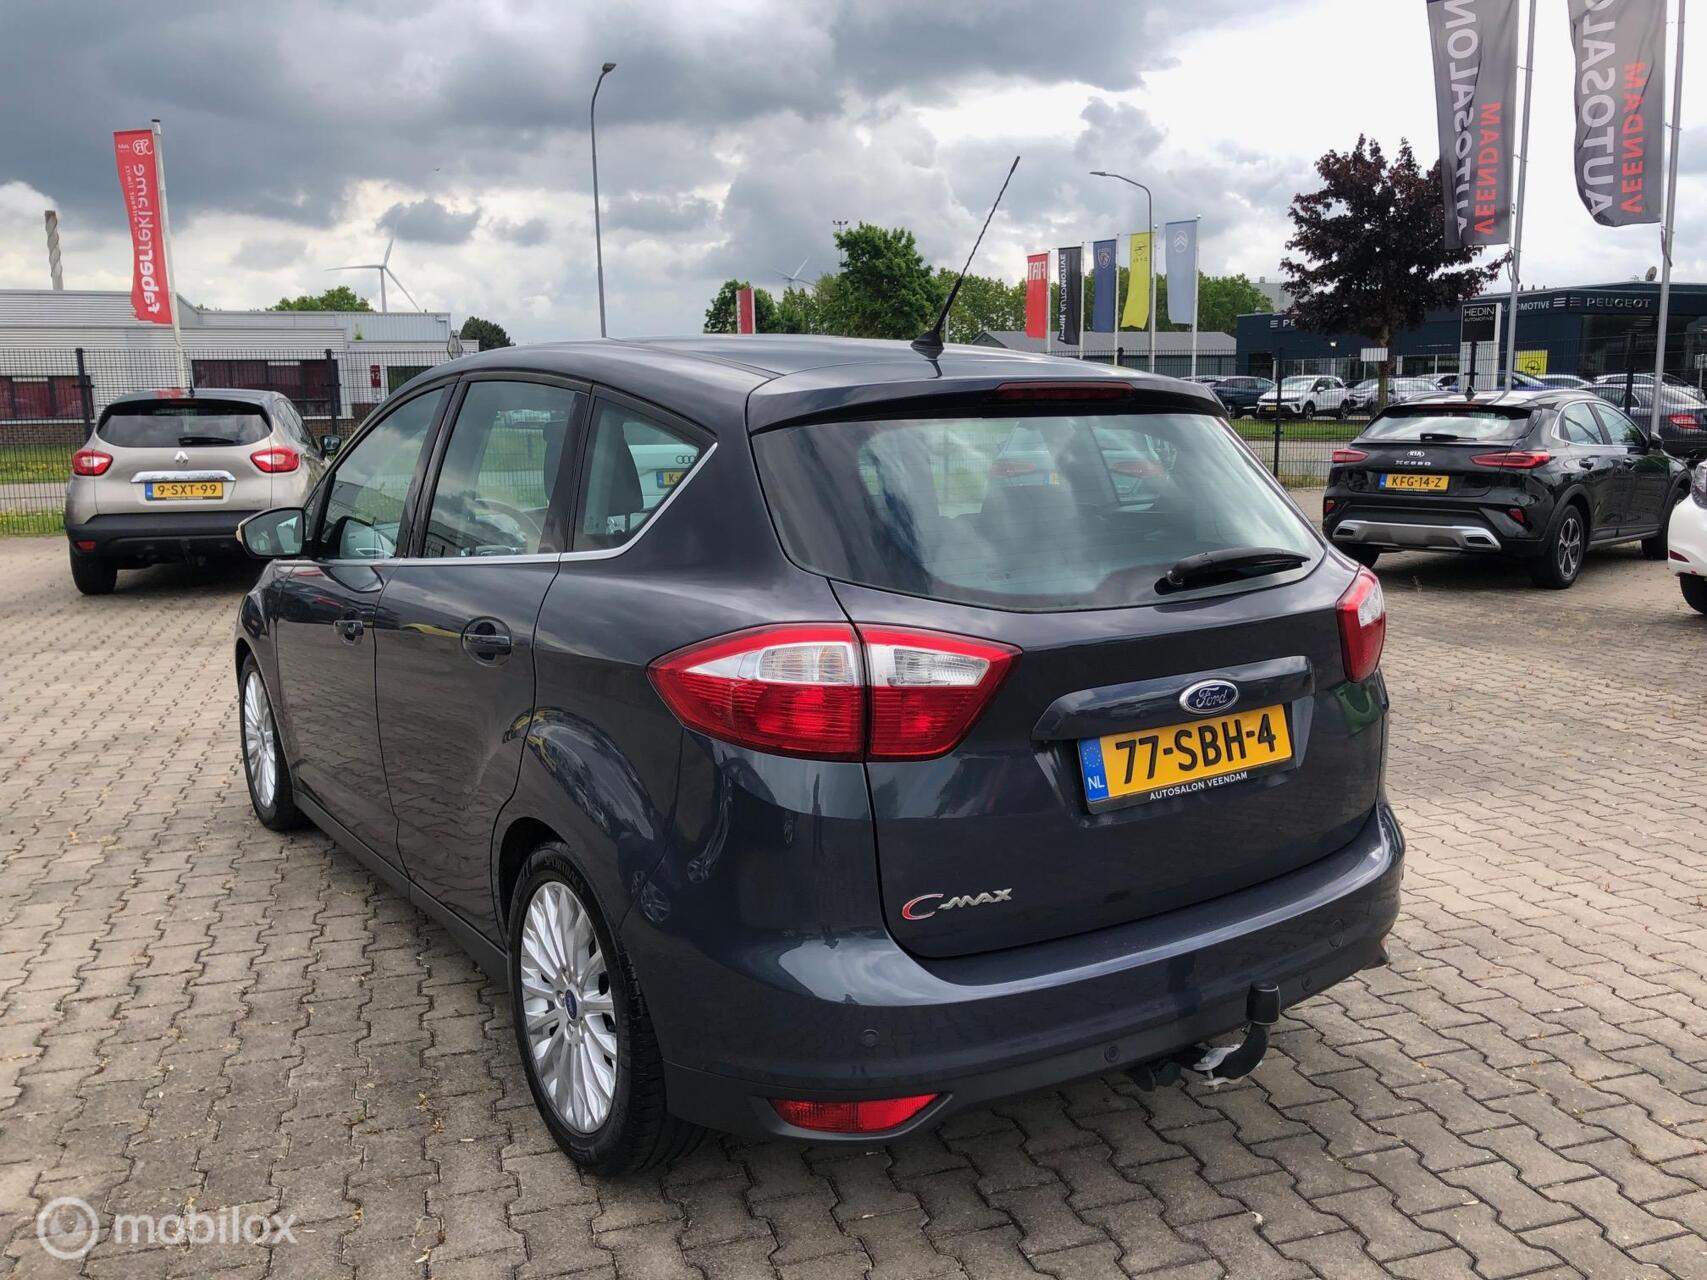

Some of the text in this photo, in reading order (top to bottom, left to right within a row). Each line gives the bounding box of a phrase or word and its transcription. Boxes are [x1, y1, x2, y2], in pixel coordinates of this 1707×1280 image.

[1586, 297, 1652, 308] PEUGEOT
[1464, 307, 1495, 317] HEDIN
[1391, 476, 1442, 488] KFG-14-Z
[157, 484, 217, 495] 9-SXT-99
[1196, 686, 1228, 708] Ford
[1115, 713, 1277, 785] 77-SBH-4
[1088, 776, 1105, 790] NL
[1150, 771, 1248, 801] AUTOSALON VEENDAM
